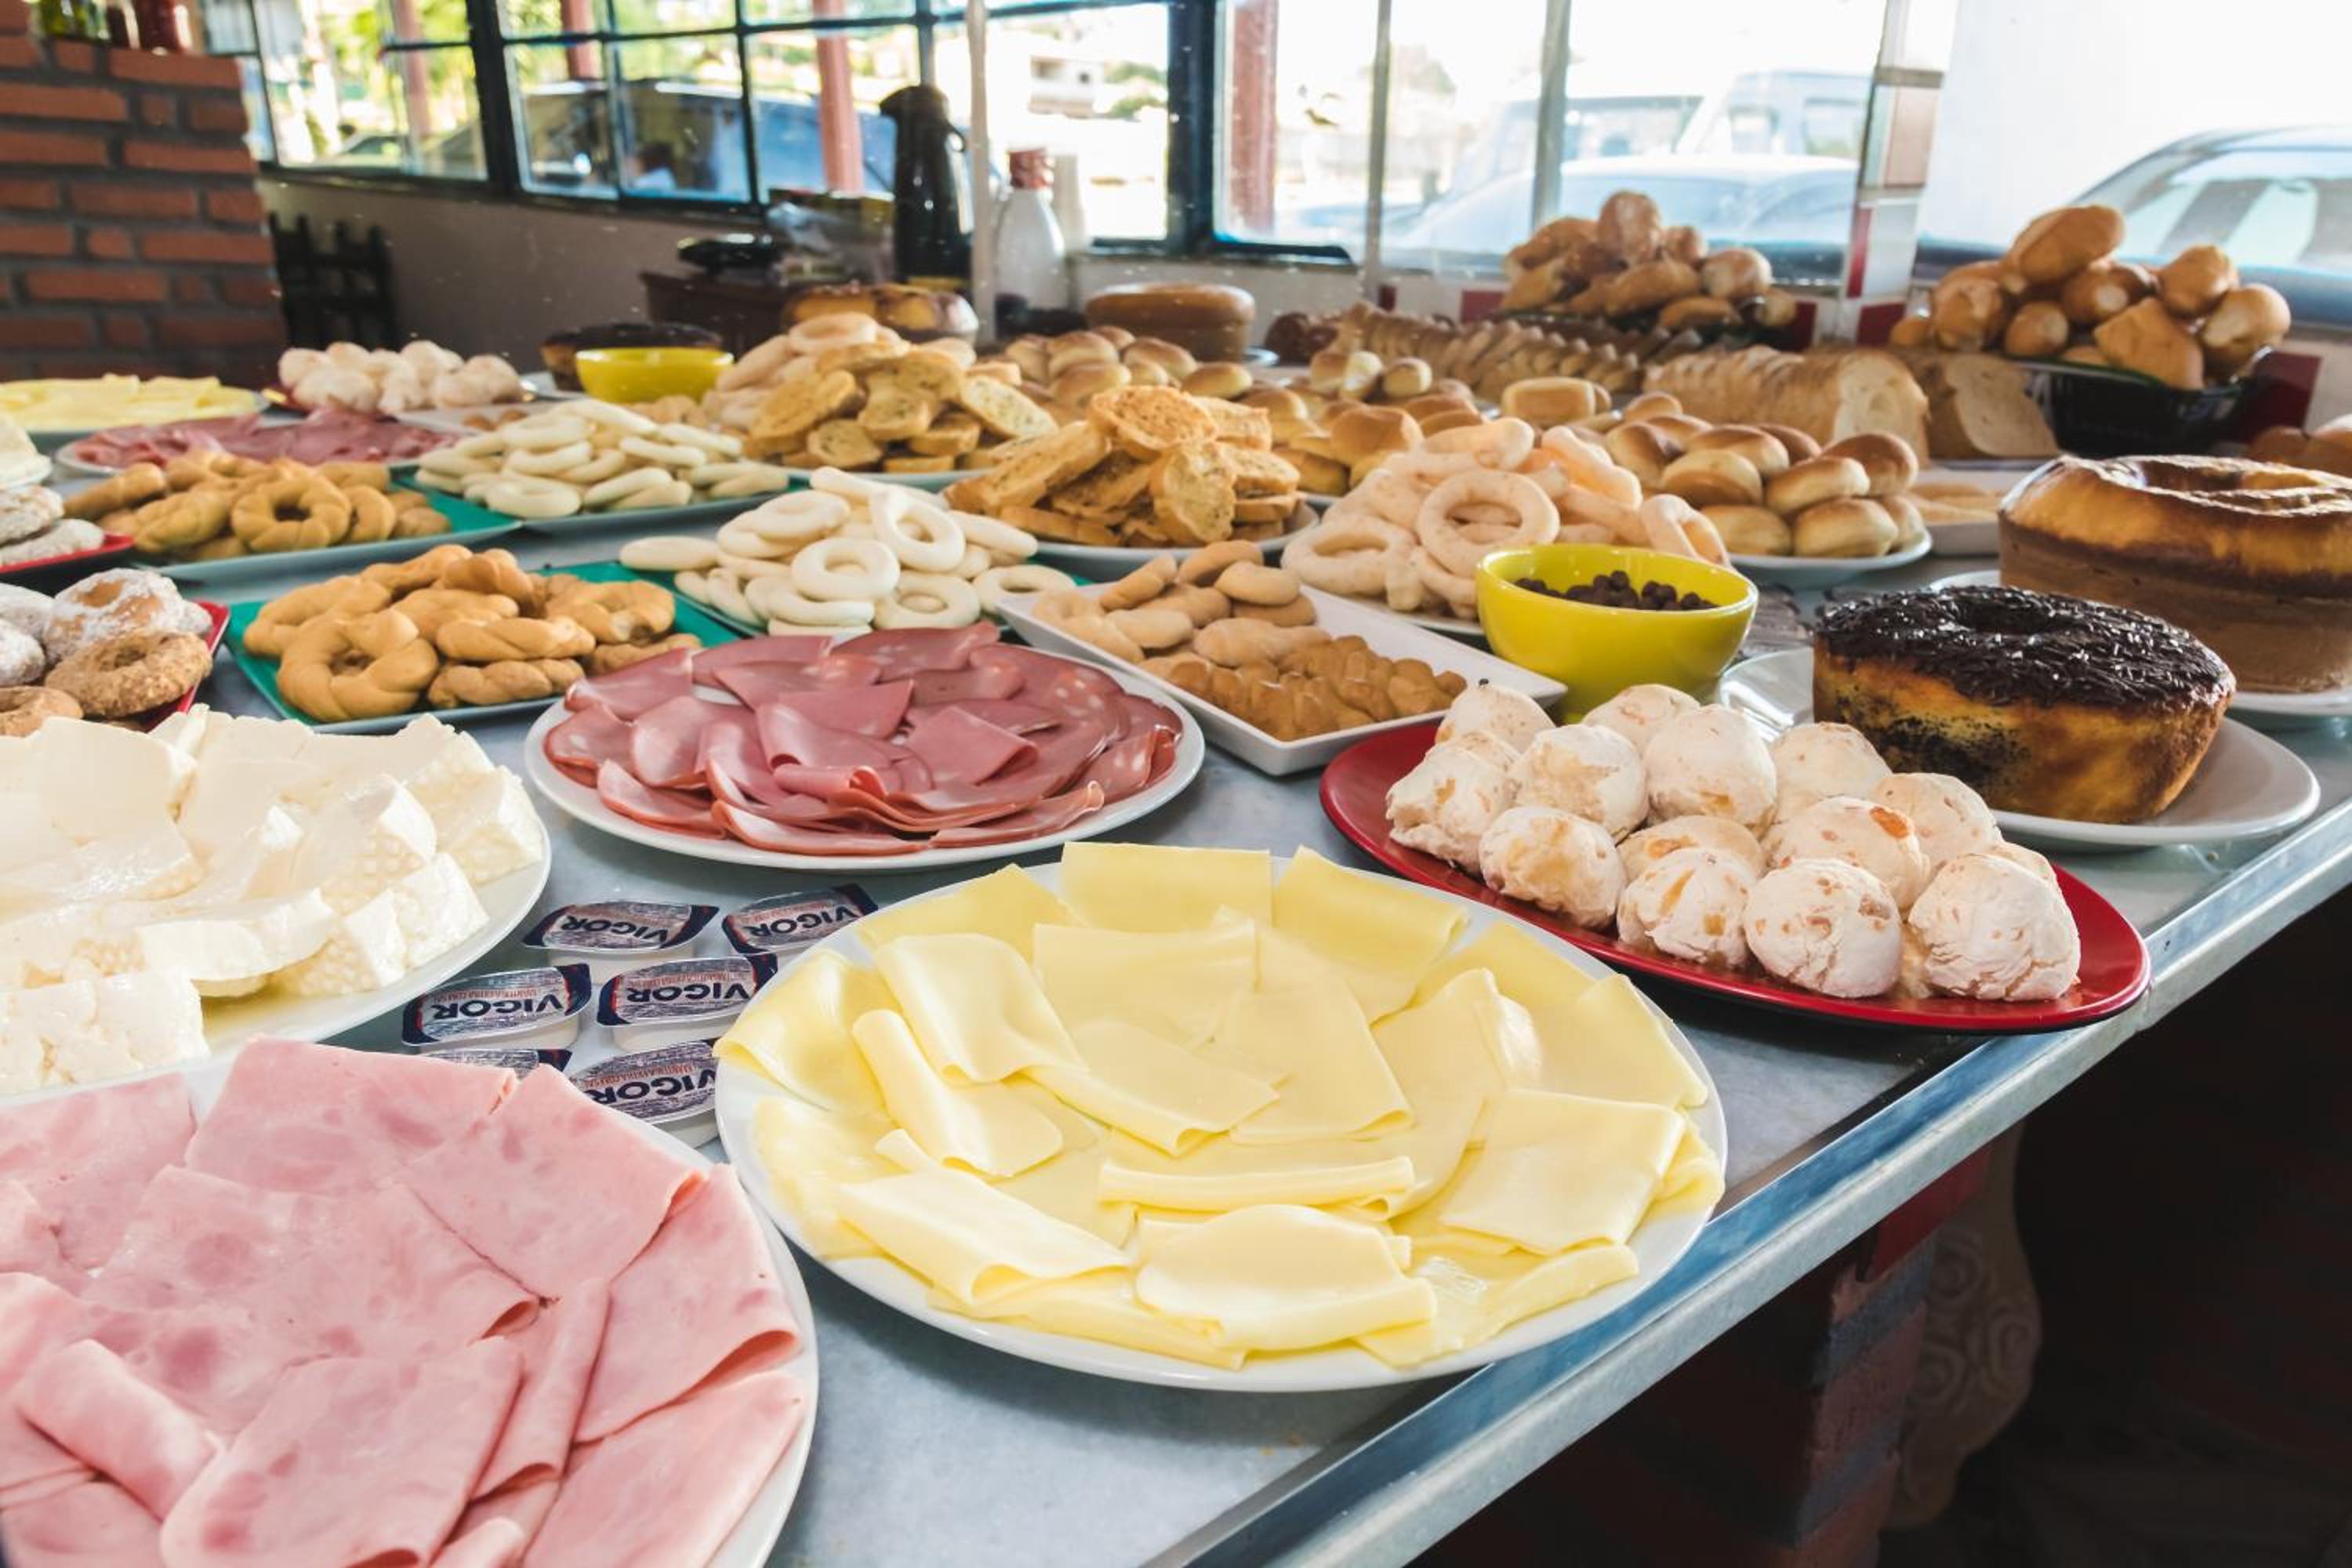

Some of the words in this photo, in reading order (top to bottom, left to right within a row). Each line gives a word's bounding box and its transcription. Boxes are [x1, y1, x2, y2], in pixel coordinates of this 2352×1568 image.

[561, 915, 669, 942] VIGOR
[744, 906, 859, 936] VIGOR
[431, 993, 563, 1019] VIGOR
[627, 982, 750, 1003] VIGOR
[584, 1069, 715, 1105] VIGOR
